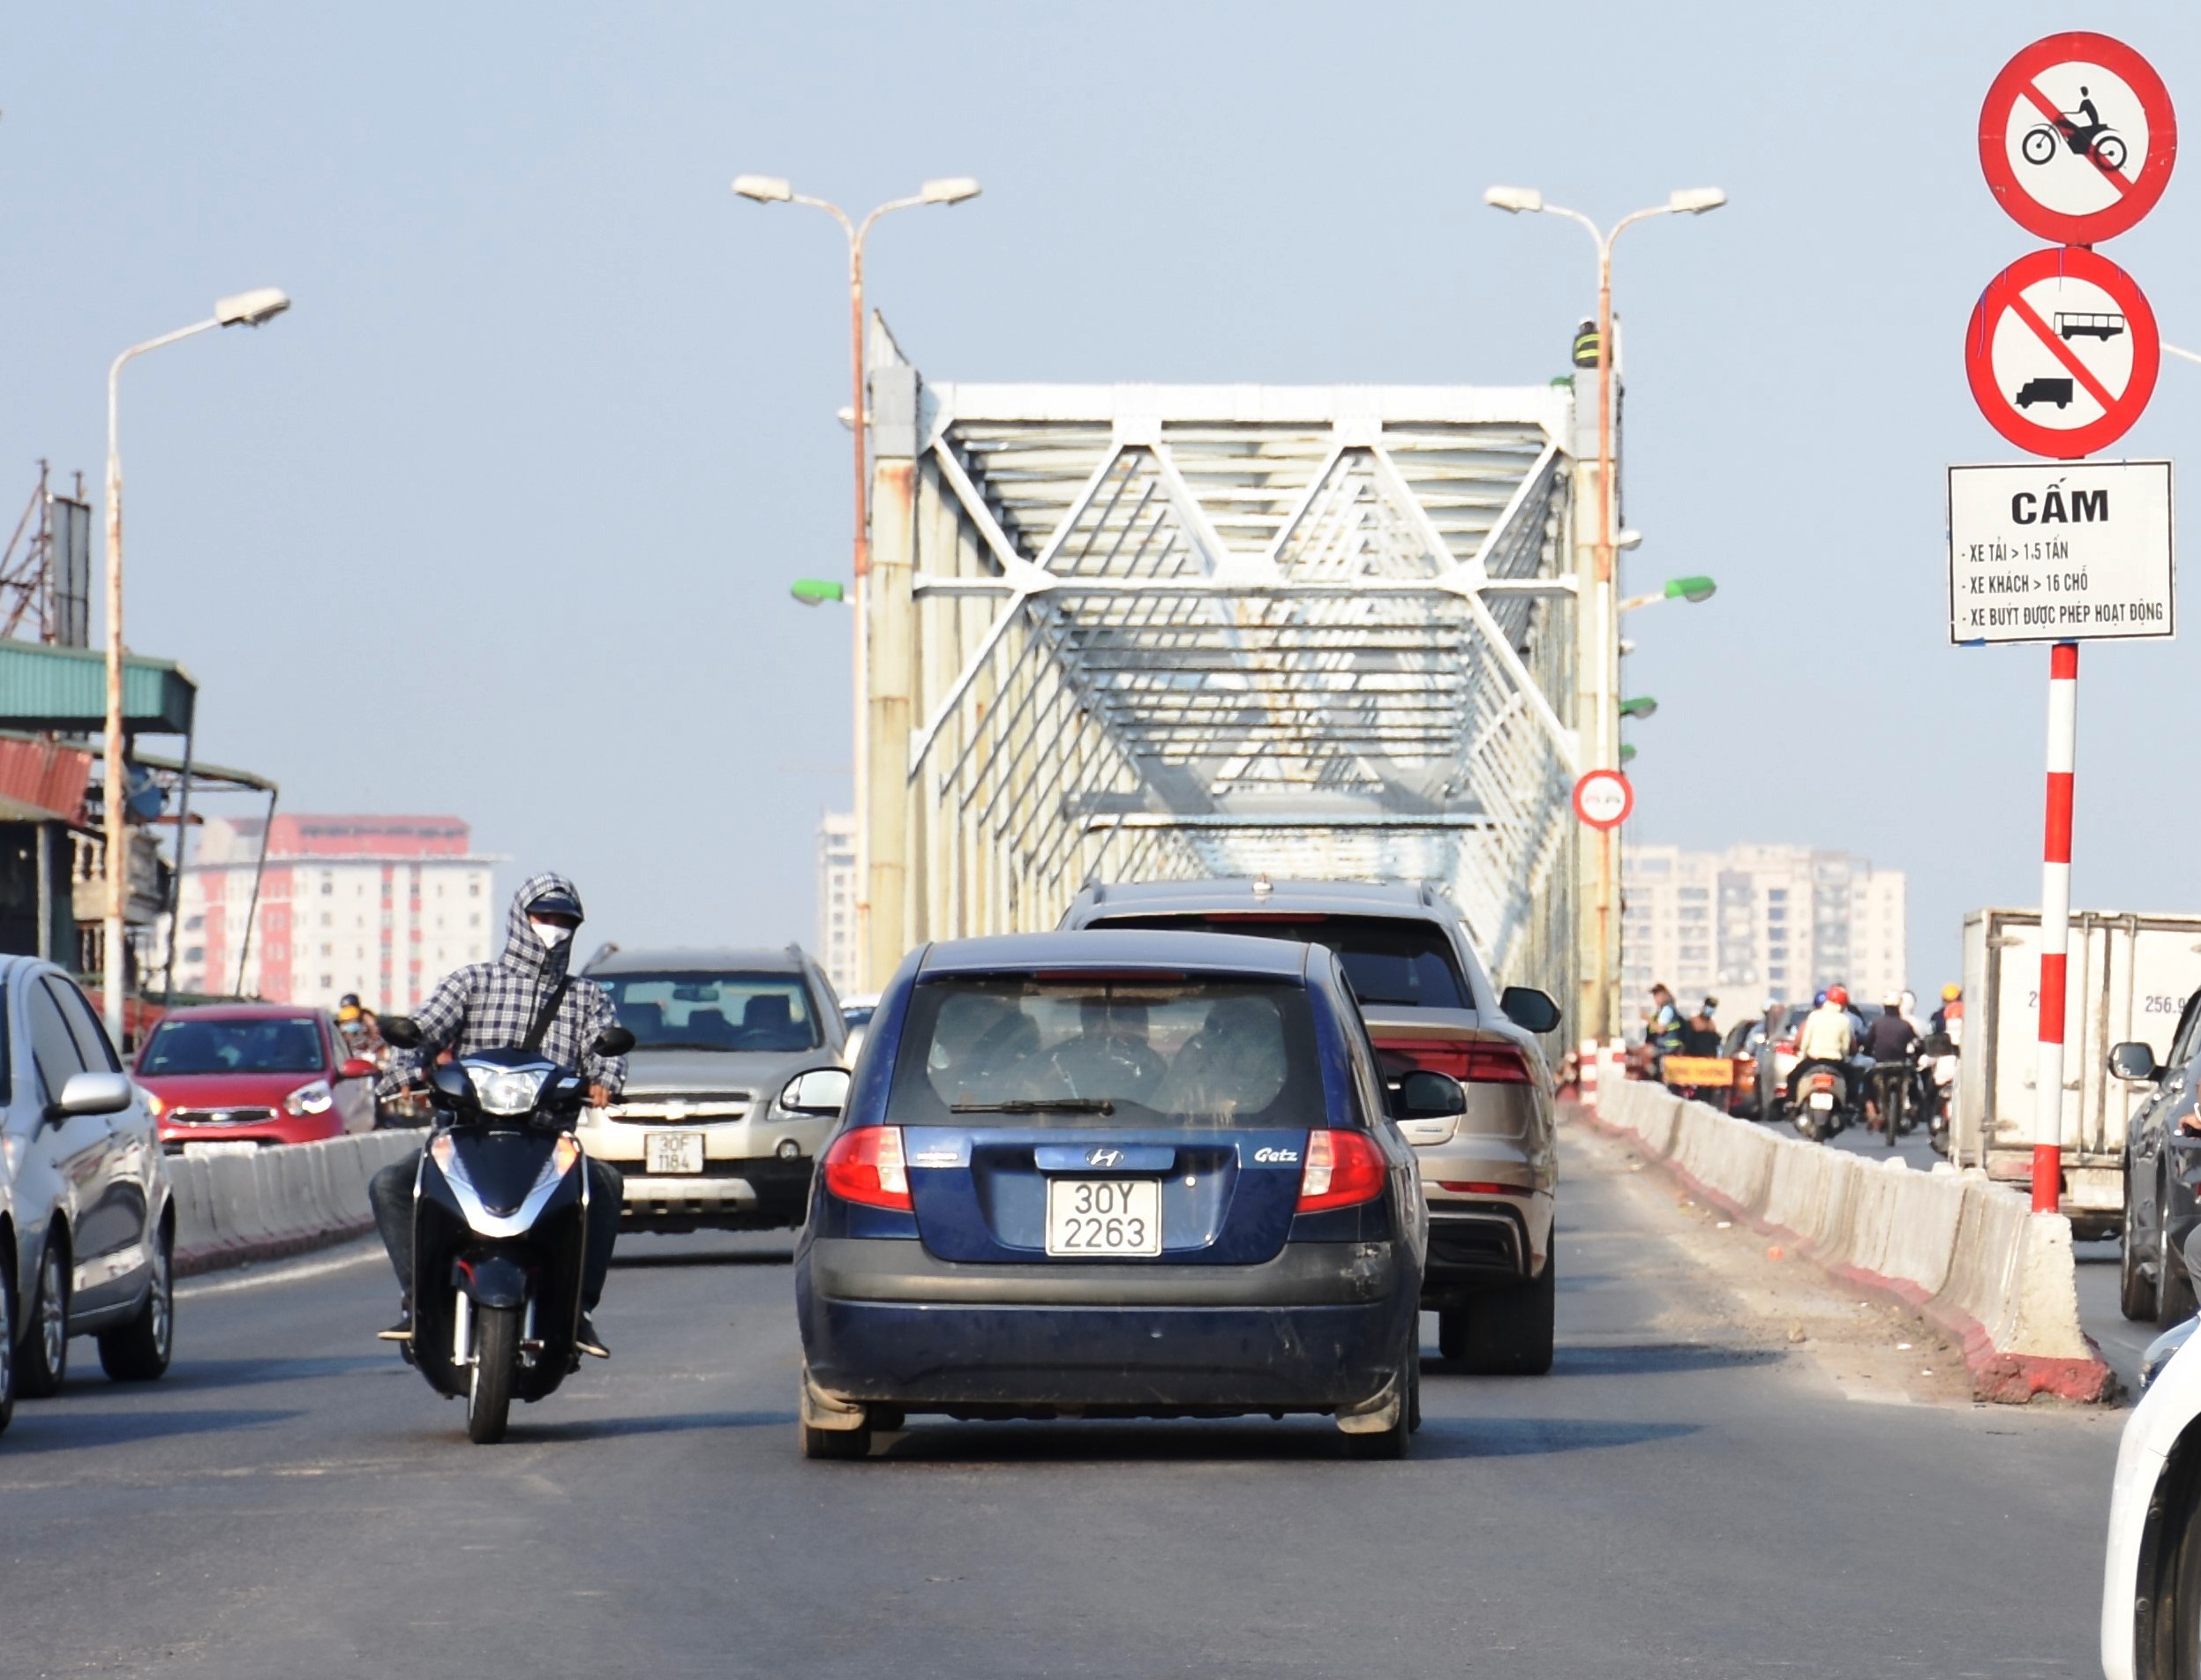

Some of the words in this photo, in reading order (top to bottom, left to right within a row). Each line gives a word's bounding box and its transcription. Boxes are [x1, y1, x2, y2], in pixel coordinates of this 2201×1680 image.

[2011, 477, 2109, 525] CẤM
[1969, 544, 1985, 562] XE
[1988, 536, 2007, 562] TẢI
[2045, 534, 2069, 560] TẤN
[1970, 575, 1985, 594] XE
[1988, 570, 2030, 594] KHÁCH
[2046, 574, 2061, 592] 16
[2063, 565, 2089, 592] CHỖ
[1970, 608, 1986, 626] XE
[1988, 603, 2020, 626] BUÝT
[2024, 604, 2056, 629] ĐƯỢC
[2059, 600, 2091, 624] PHÉP
[2094, 604, 2126, 626] HOẠT
[2130, 598, 2164, 626] ĐỘNG
[1254, 1147, 1298, 1163] Getz
[1074, 1183, 1135, 1215] 30Y
[1063, 1217, 1146, 1248] 2263
